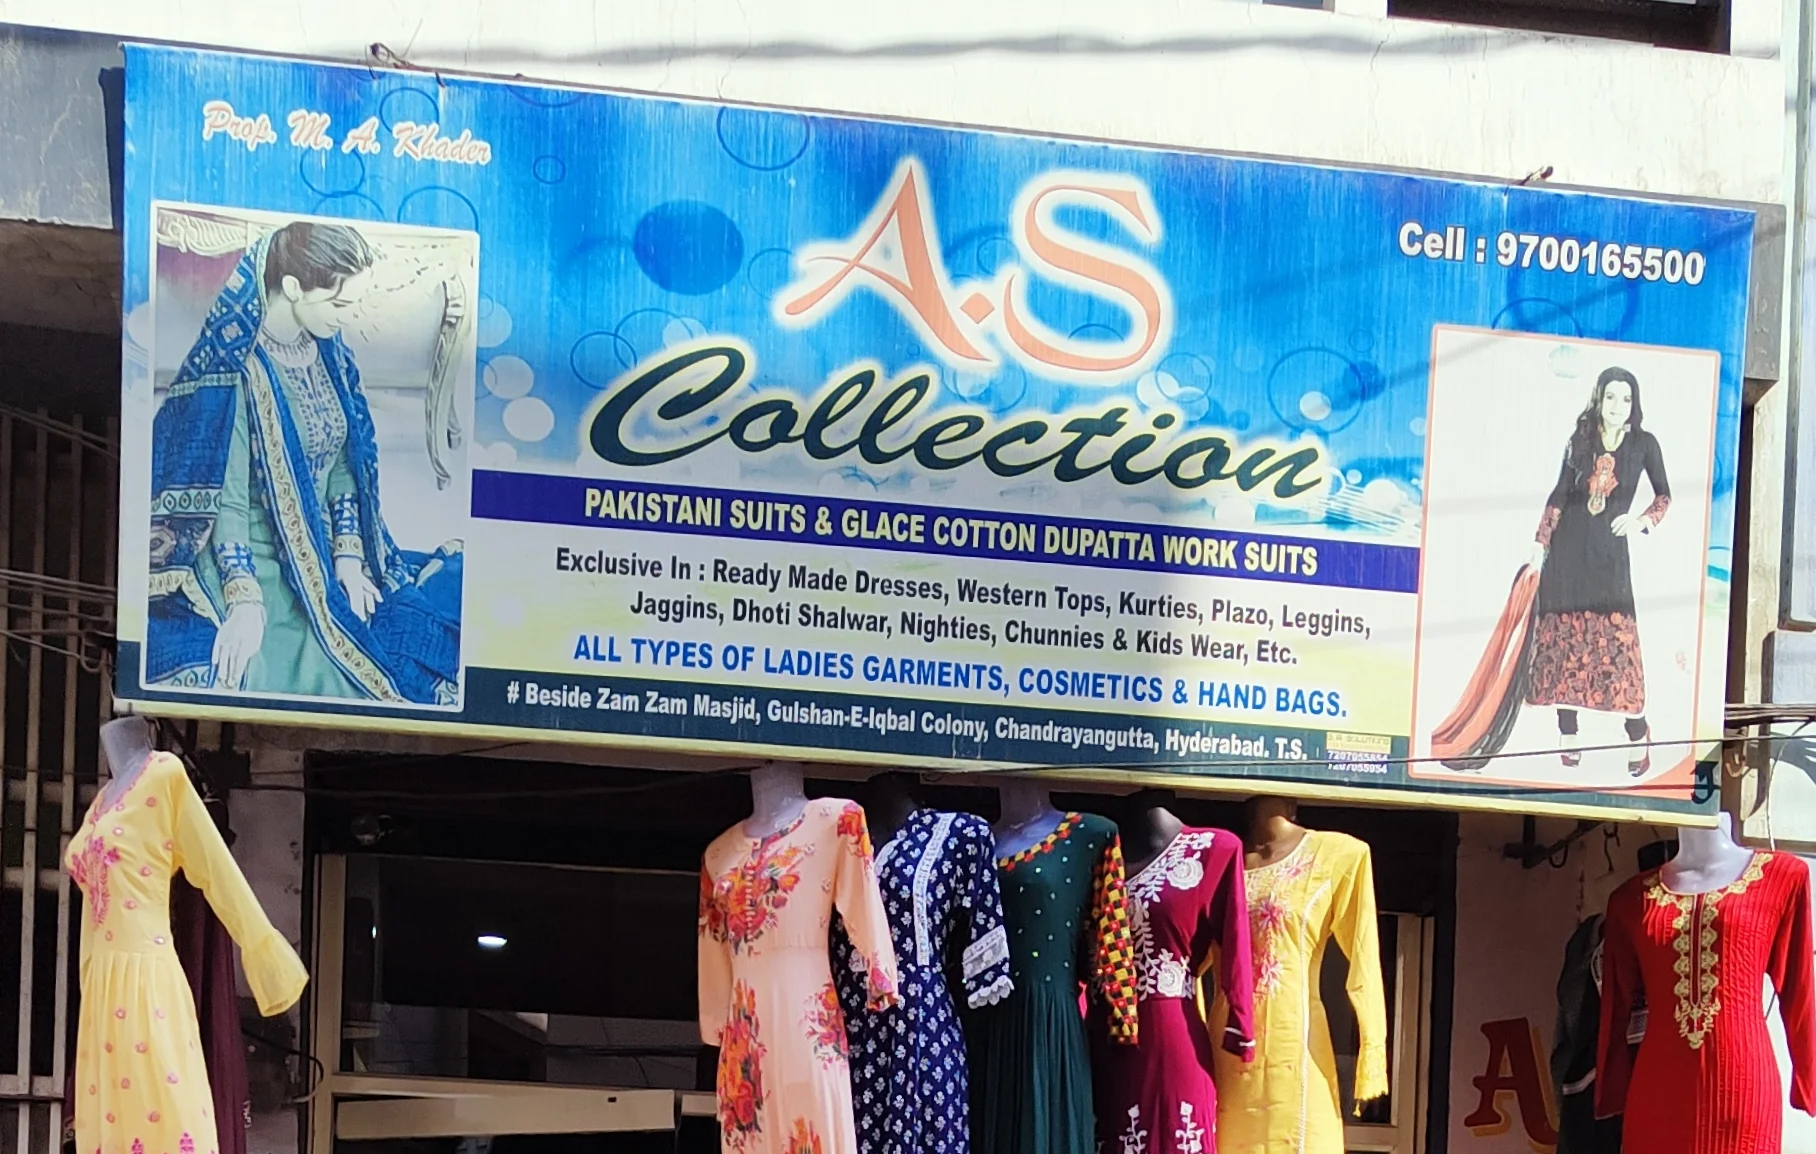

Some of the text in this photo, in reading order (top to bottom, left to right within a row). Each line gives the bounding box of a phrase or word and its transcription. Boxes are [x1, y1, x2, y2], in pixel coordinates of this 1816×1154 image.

[288, 110, 333, 149] M.
[341, 117, 379, 153] A.
[393, 122, 490, 164] Khader
[1399, 222, 1465, 261] Cell
[1497, 231, 1705, 285] 9700165500
[589, 345, 1324, 499] Collection
[584, 487, 1318, 576] PAKISTANI SUITS & GLACE COTTON DUPATTA WORK SUITS
[556, 547, 663, 579] Exclusive
[671, 555, 691, 580] In
[713, 559, 782, 593] Ready
[788, 564, 848, 592] Made
[855, 570, 949, 603] Dresses,
[958, 578, 1047, 609] Western
[1055, 586, 1111, 616] Tops,
[1119, 591, 1203, 624] Kurties,
[1212, 599, 1274, 631] Plazo,
[1282, 604, 1371, 639] Leggins,
[630, 591, 1298, 666] Jaggins, Dhoti Shalwar, Nighties, Chunnies & Kids Wear, Etc.
[574, 635, 1347, 717] ALL TYPES OF LADIES GARMENTS, COSMETICS & HAND BAGS.
[507, 680, 520, 704] #
[525, 682, 592, 709] Beside
[596, 687, 640, 712] Zam
[645, 691, 688, 716] Zam
[694, 694, 761, 725] Masjid,
[767, 699, 915, 735] Gulshan-E-Iqbal
[921, 711, 989, 743] Colony,
[995, 716, 1159, 754] Chandrayangutta,
[1275, 737, 1308, 760] T.S.
